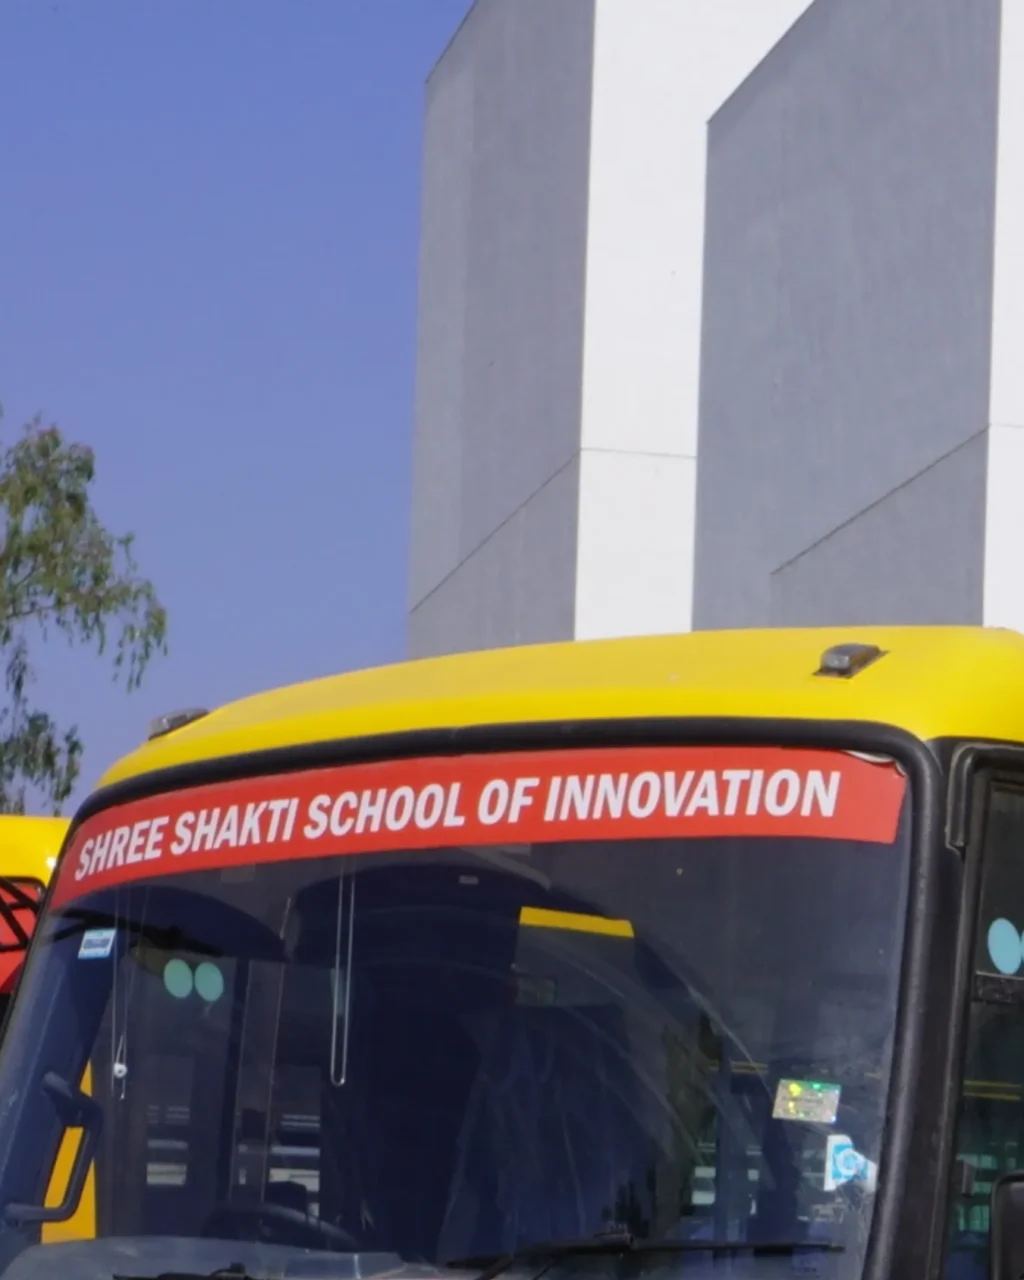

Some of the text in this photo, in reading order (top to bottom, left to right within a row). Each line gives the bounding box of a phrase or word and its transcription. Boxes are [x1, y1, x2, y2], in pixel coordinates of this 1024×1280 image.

[76, 769, 841, 881] SHREE SHAKTI SCHOOL OF INNOVATION
